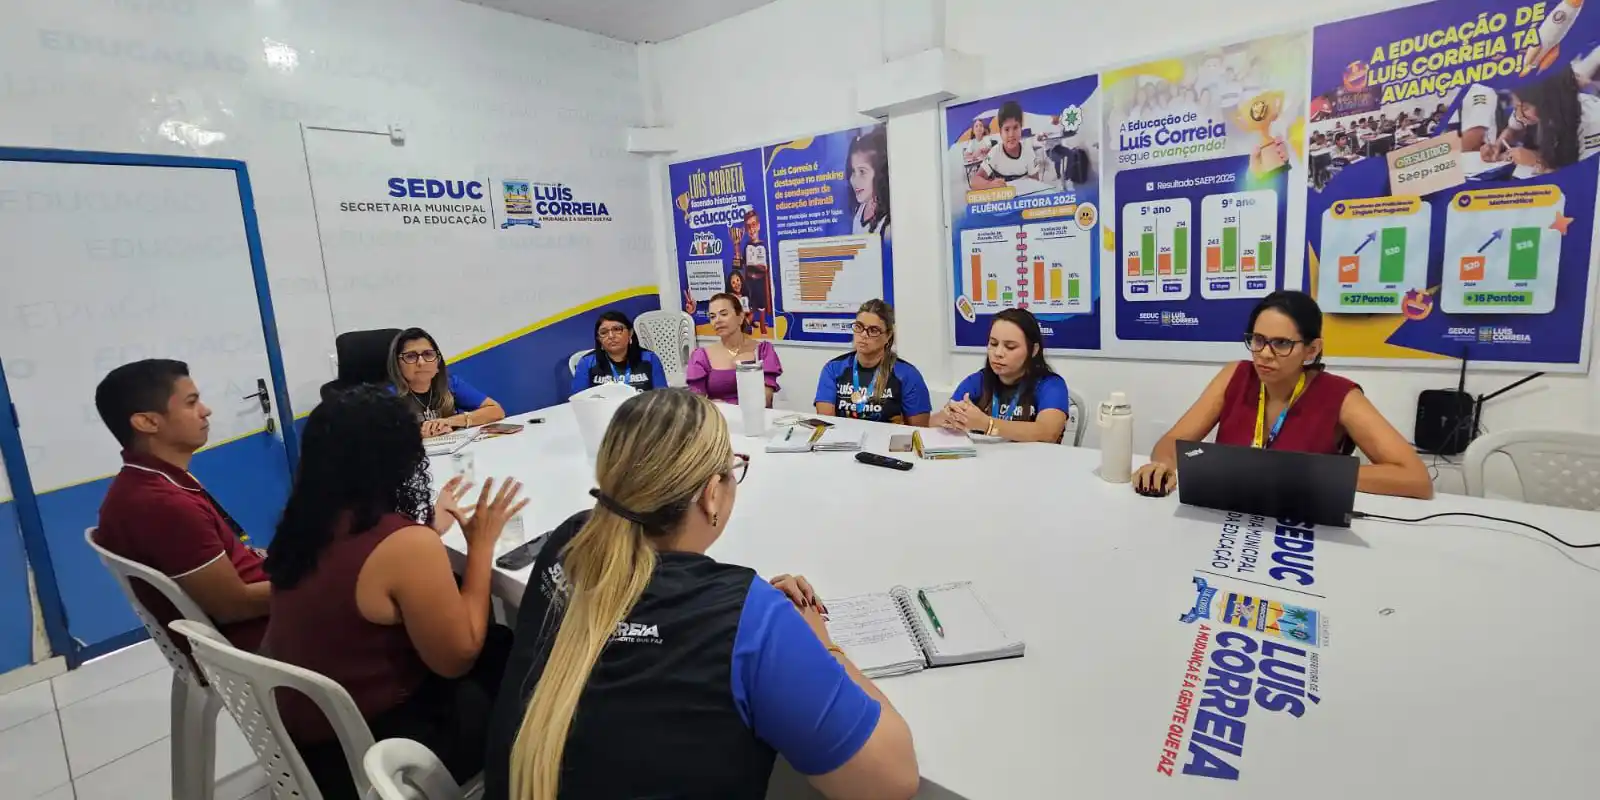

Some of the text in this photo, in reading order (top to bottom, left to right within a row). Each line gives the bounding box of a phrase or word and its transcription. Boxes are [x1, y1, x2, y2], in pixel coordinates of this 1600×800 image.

[1370, 2, 1547, 65] A EDUCAÇÃO DE
[1367, 23, 1540, 86] LUÍS CORREIA TÁ
[1380, 53, 1522, 104] AVANÇANDO!
[1120, 112, 1197, 133] A Educação de
[1120, 119, 1226, 152] Luís Correia
[1119, 139, 1227, 165] segue avançando!
[689, 166, 745, 199] LUÍS CORREIA
[1157, 173, 1236, 190] Resultado SAEPI 2025
[1398, 160, 1456, 183] Saepi 2025
[388, 177, 483, 200] SEDUC
[534, 183, 573, 201] LUÍS
[340, 202, 487, 213] SECRETARIA MUNICIPAL
[536, 201, 609, 216] CORREIA
[693, 204, 746, 225] educação
[971, 202, 1012, 214] FLUÊNCIA
[1013, 197, 1051, 210] LEITORA
[1053, 194, 1076, 206] 2025
[1141, 206, 1171, 215] 5º ano
[1222, 198, 1255, 208] 9º ano
[403, 214, 487, 226] DA EDUCAÇÃO
[1363, 295, 1395, 303] Pontos
[1487, 294, 1525, 302] Pontos
[1493, 326, 1513, 334] LUÍS
[1211, 512, 1242, 569] DA EDUCAÇÃO
[1237, 528, 1262, 573] MUNICIPAL
[1269, 516, 1314, 585] SEDUC
[1254, 640, 1321, 719] LUÍS
[1157, 624, 1211, 777] A MUDANÇA É A GENTE QUE FAZ
[1182, 631, 1259, 781] CORREIA
